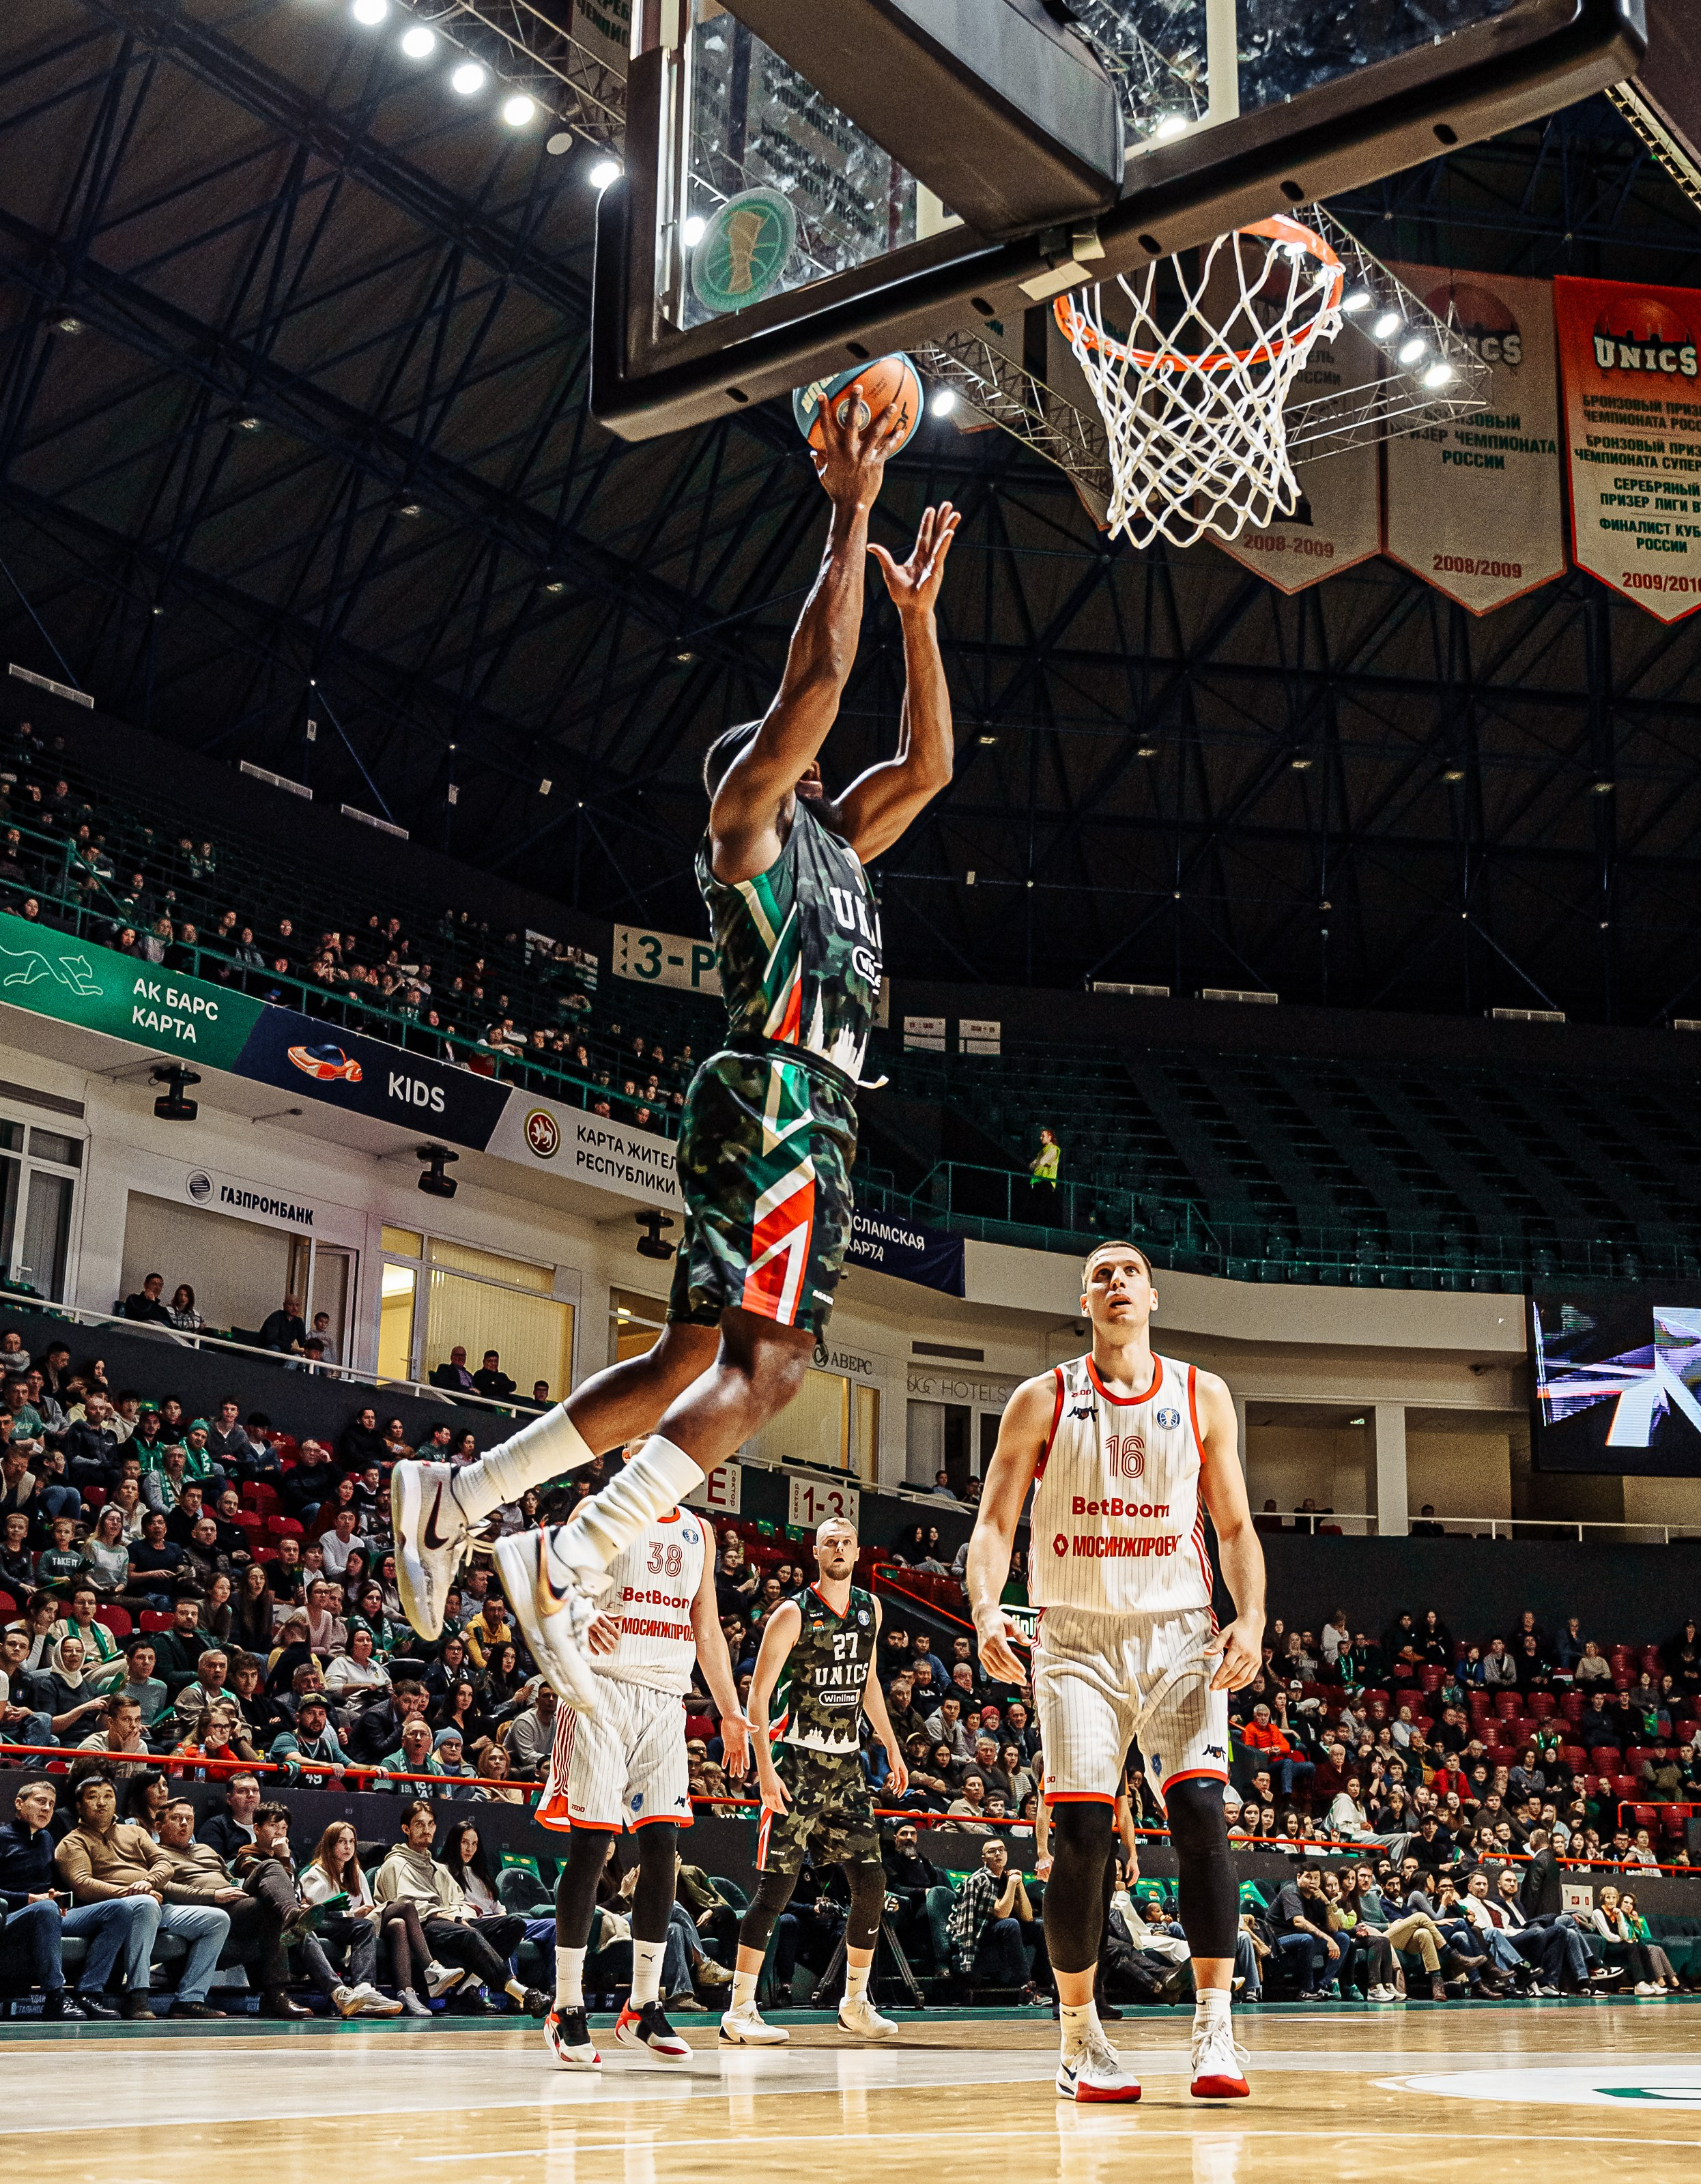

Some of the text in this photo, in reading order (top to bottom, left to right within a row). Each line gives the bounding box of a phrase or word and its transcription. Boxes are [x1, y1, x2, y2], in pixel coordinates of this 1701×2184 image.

[1594, 336, 1698, 375] UNICS
[1582, 394, 1663, 413] БРОНЗОВЫЙ
[1584, 410, 1667, 429] ЧЕМПИОНАТА
[1455, 430, 1557, 455] ЧЕМПИОНАТА
[1586, 433, 1666, 454] БРОНЗОВЫЙ
[1442, 449, 1505, 470] РОССИИ
[1574, 448, 1659, 469] ЧЕМПИОНАТА
[1614, 477, 1700, 497] СЕРЕБРЯНЫЙ
[1600, 493, 1650, 508] ПРИЗЕР
[1655, 498, 1688, 513] ЛИГИ
[1599, 518, 1671, 535] ФИНАЛИСТ
[1243, 533, 1334, 558] 2008-2009
[1636, 536, 1687, 554] РОССИИ
[1433, 554, 1523, 579] 2008/2009
[133, 978, 218, 1020] АК БАРС
[132, 1005, 197, 1044] КАРТА
[388, 1072, 445, 1112] KIDS
[577, 1125, 624, 1155] КАРТА
[576, 1150, 675, 1196] РЕСПУБЛИКИ
[220, 1186, 314, 1226] ГАЗПРОМБАНК
[831, 1351, 872, 1375] АВЕРС
[942, 1379, 1007, 1403] HOTELS
[1105, 1435, 1145, 1478] 16
[1072, 1496, 1169, 1518] BetBoom
[53, 1557, 71, 1566] TAKE
[647, 1541, 682, 1577] 38
[833, 1632, 858, 1661] 27
[815, 1663, 869, 1686] UNICS
[824, 1694, 855, 1703] Winline
